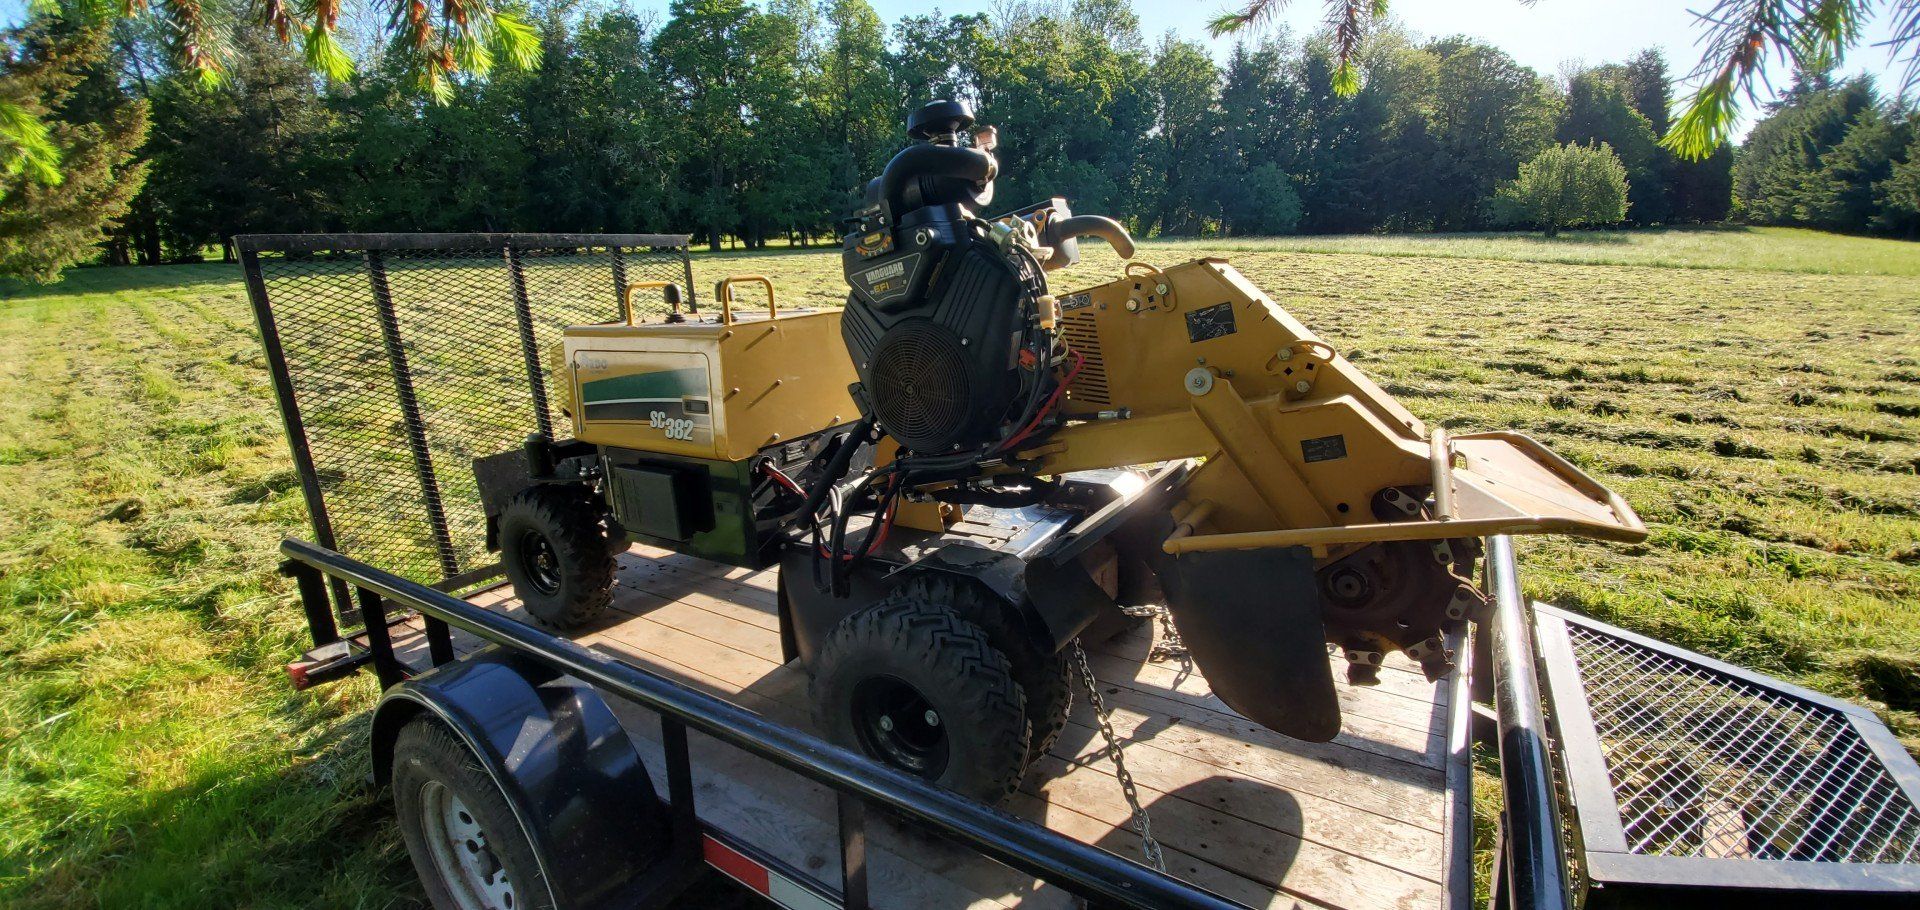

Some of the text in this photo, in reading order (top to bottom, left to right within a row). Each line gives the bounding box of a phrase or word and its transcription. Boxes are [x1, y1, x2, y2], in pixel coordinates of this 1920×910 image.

[865, 262, 904, 282] VANGUARD
[873, 281, 890, 293] EFI
[650, 410, 694, 441] SC 382
